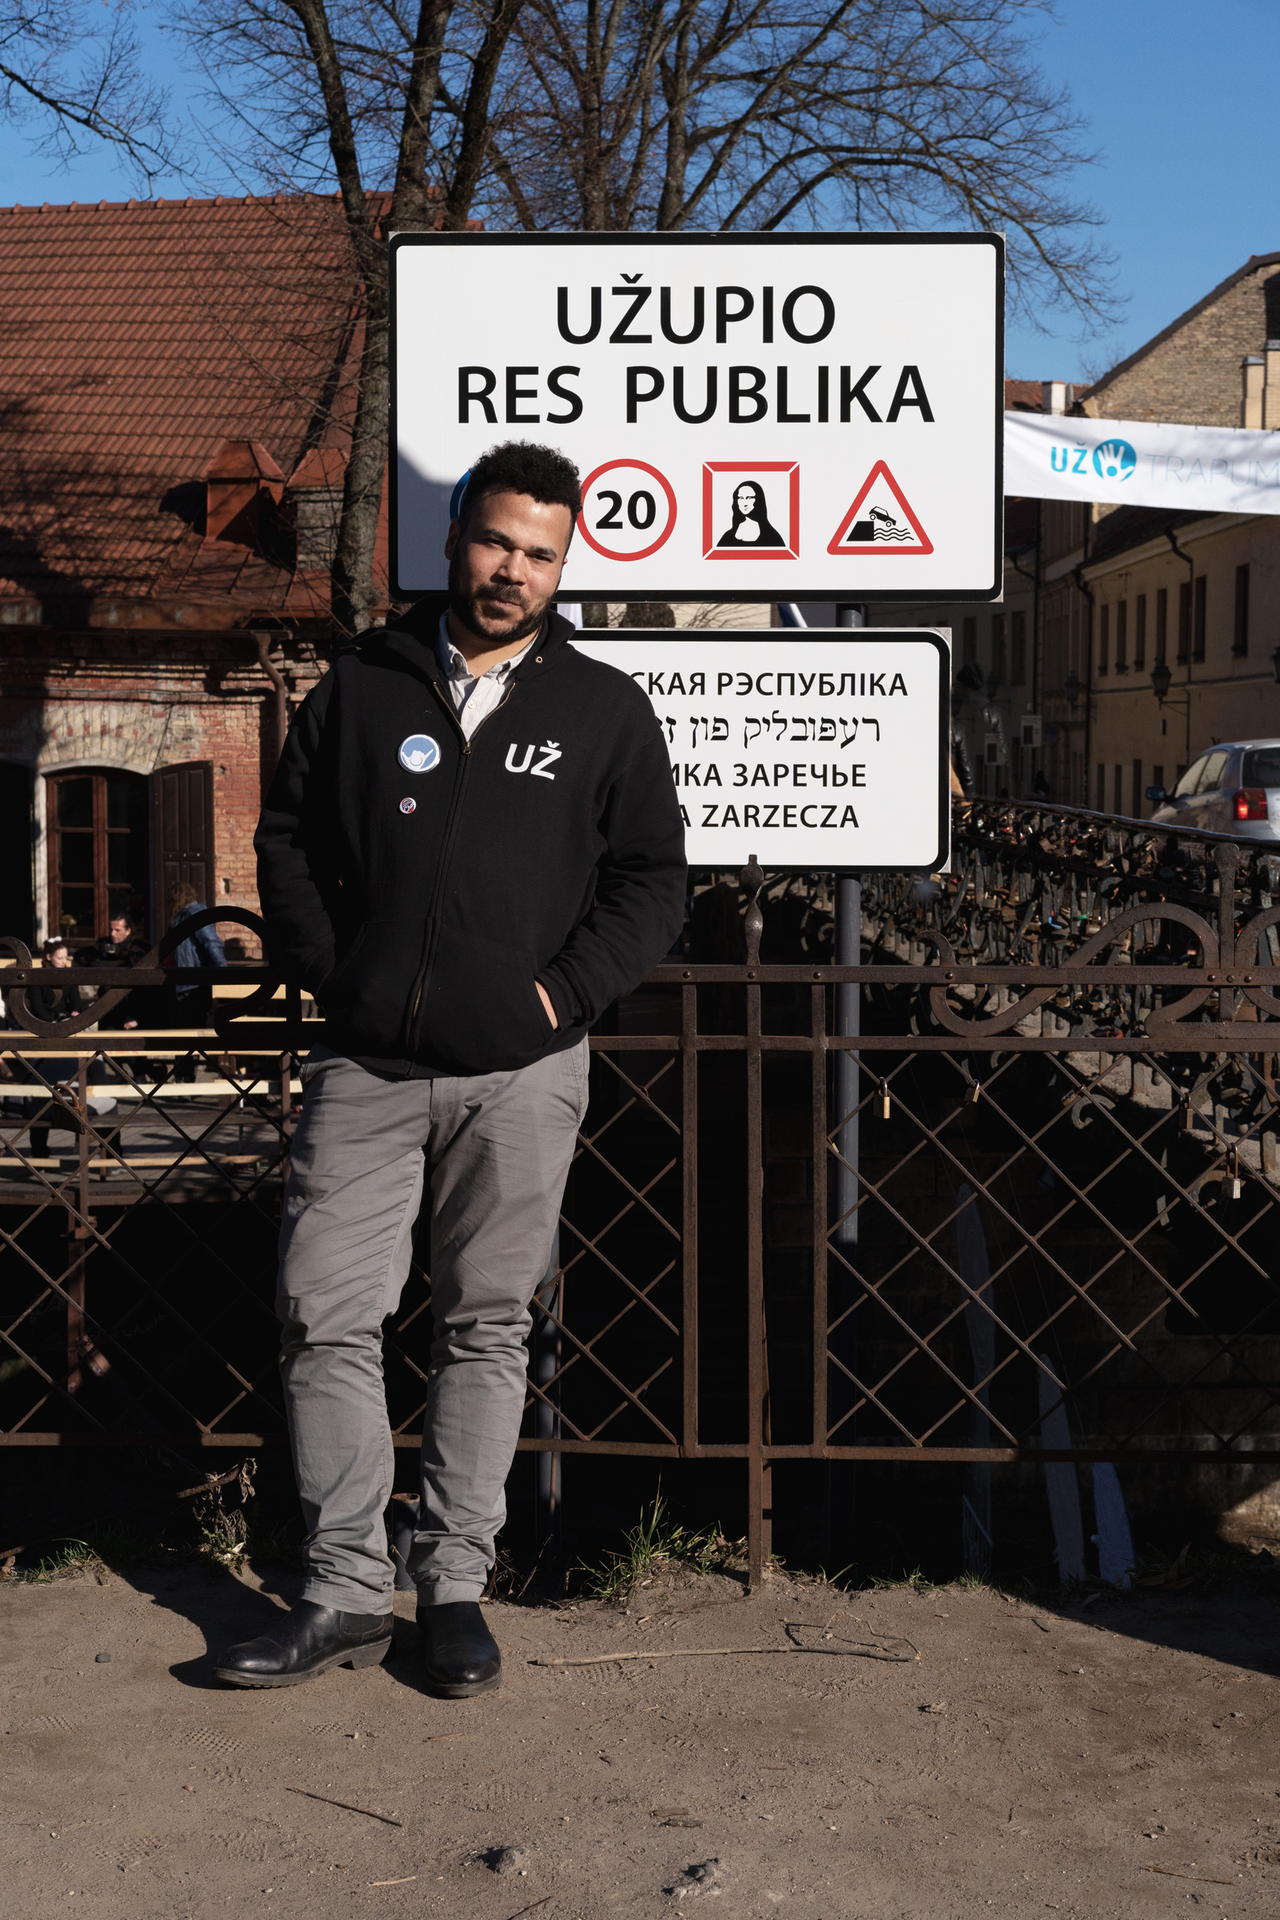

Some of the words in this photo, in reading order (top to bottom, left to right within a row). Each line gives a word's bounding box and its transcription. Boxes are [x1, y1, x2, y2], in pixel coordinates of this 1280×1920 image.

[557, 273, 836, 345] UŽUPIO
[458, 365, 583, 425] RES
[626, 365, 935, 424] PUBLIKA
[1050, 441, 1088, 475] UŽ
[595, 490, 656, 530] 20
[717, 672, 908, 696] РЭСПУБЛІКА
[504, 739, 563, 781] UŽ
[732, 763, 867, 787] ЗАРЕЧЬЕ
[701, 804, 860, 828] ZARZECZA
